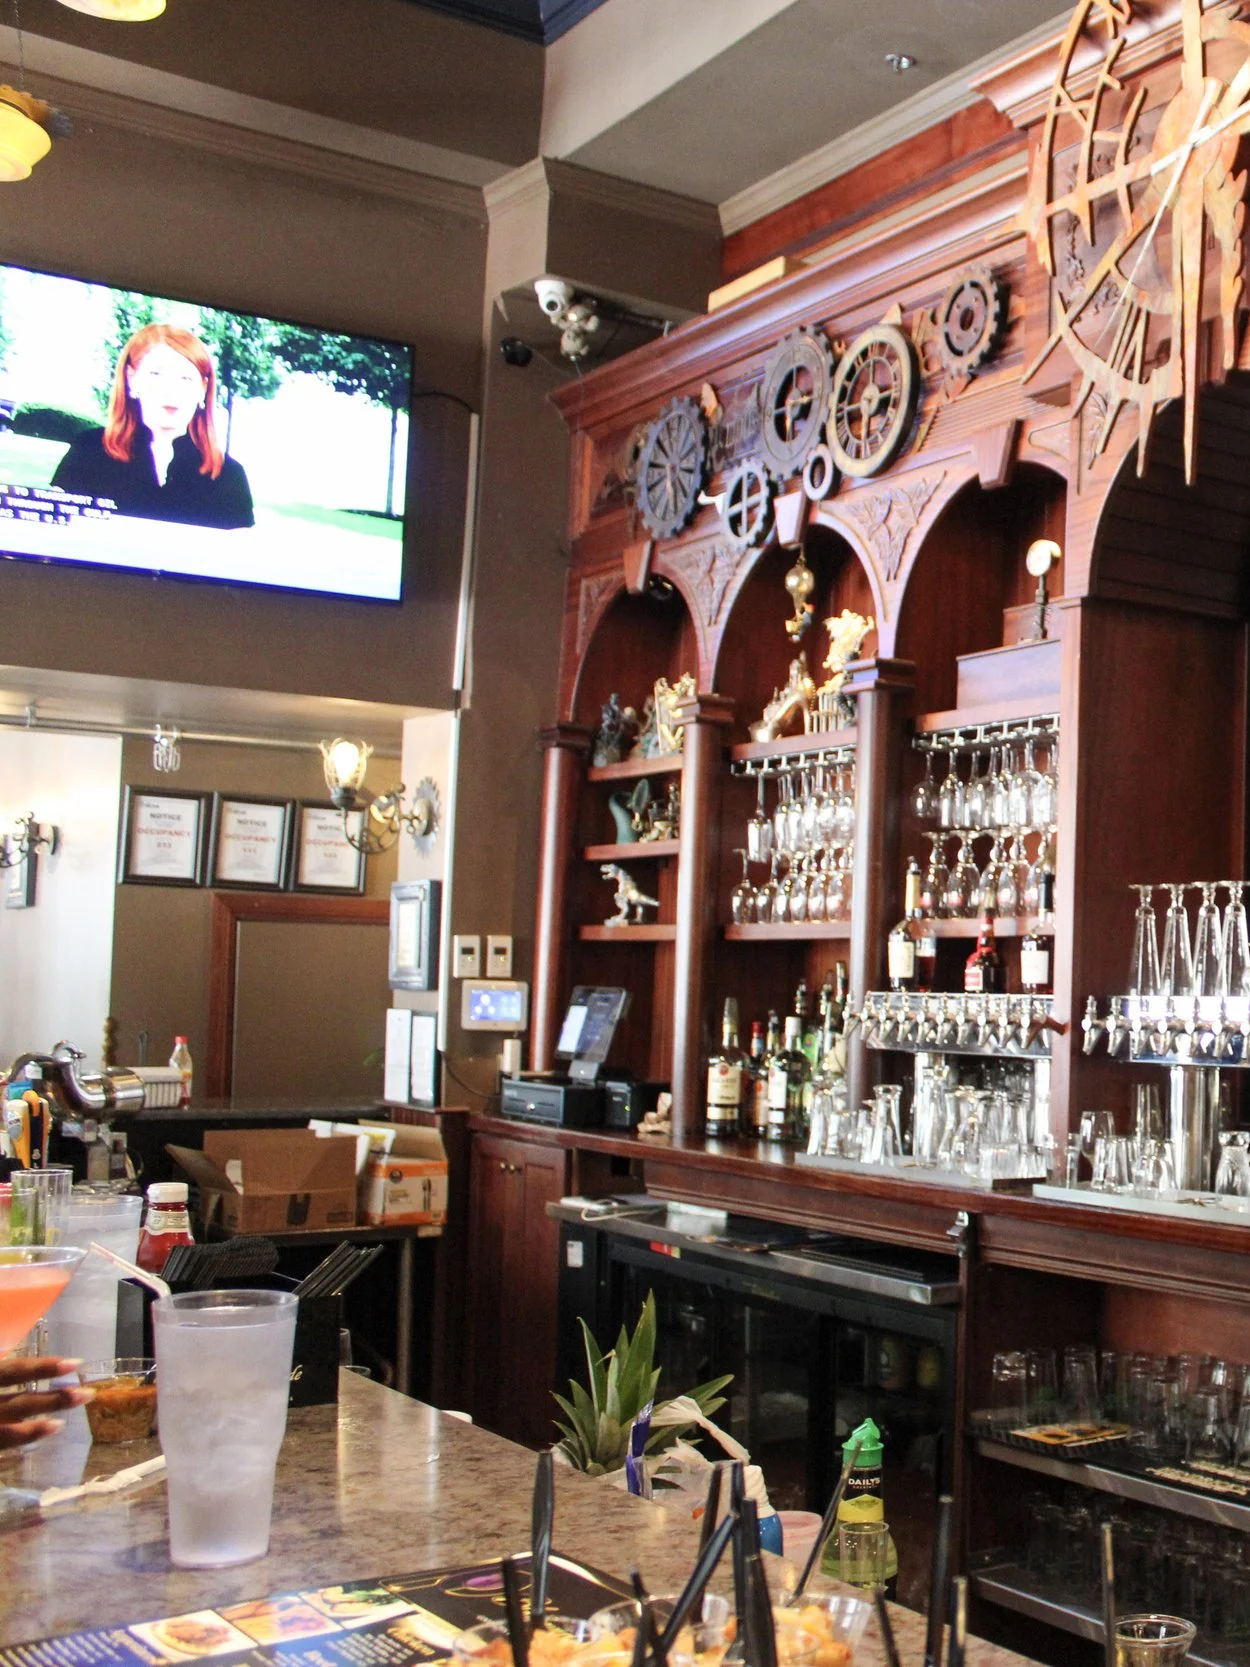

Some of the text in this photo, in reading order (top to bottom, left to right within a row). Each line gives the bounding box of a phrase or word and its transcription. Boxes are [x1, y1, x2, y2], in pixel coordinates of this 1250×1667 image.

[149, 812, 182, 822] NOTICE
[136, 827, 192, 839] OCCUPANCY
[317, 824, 341, 834] NOTIC
